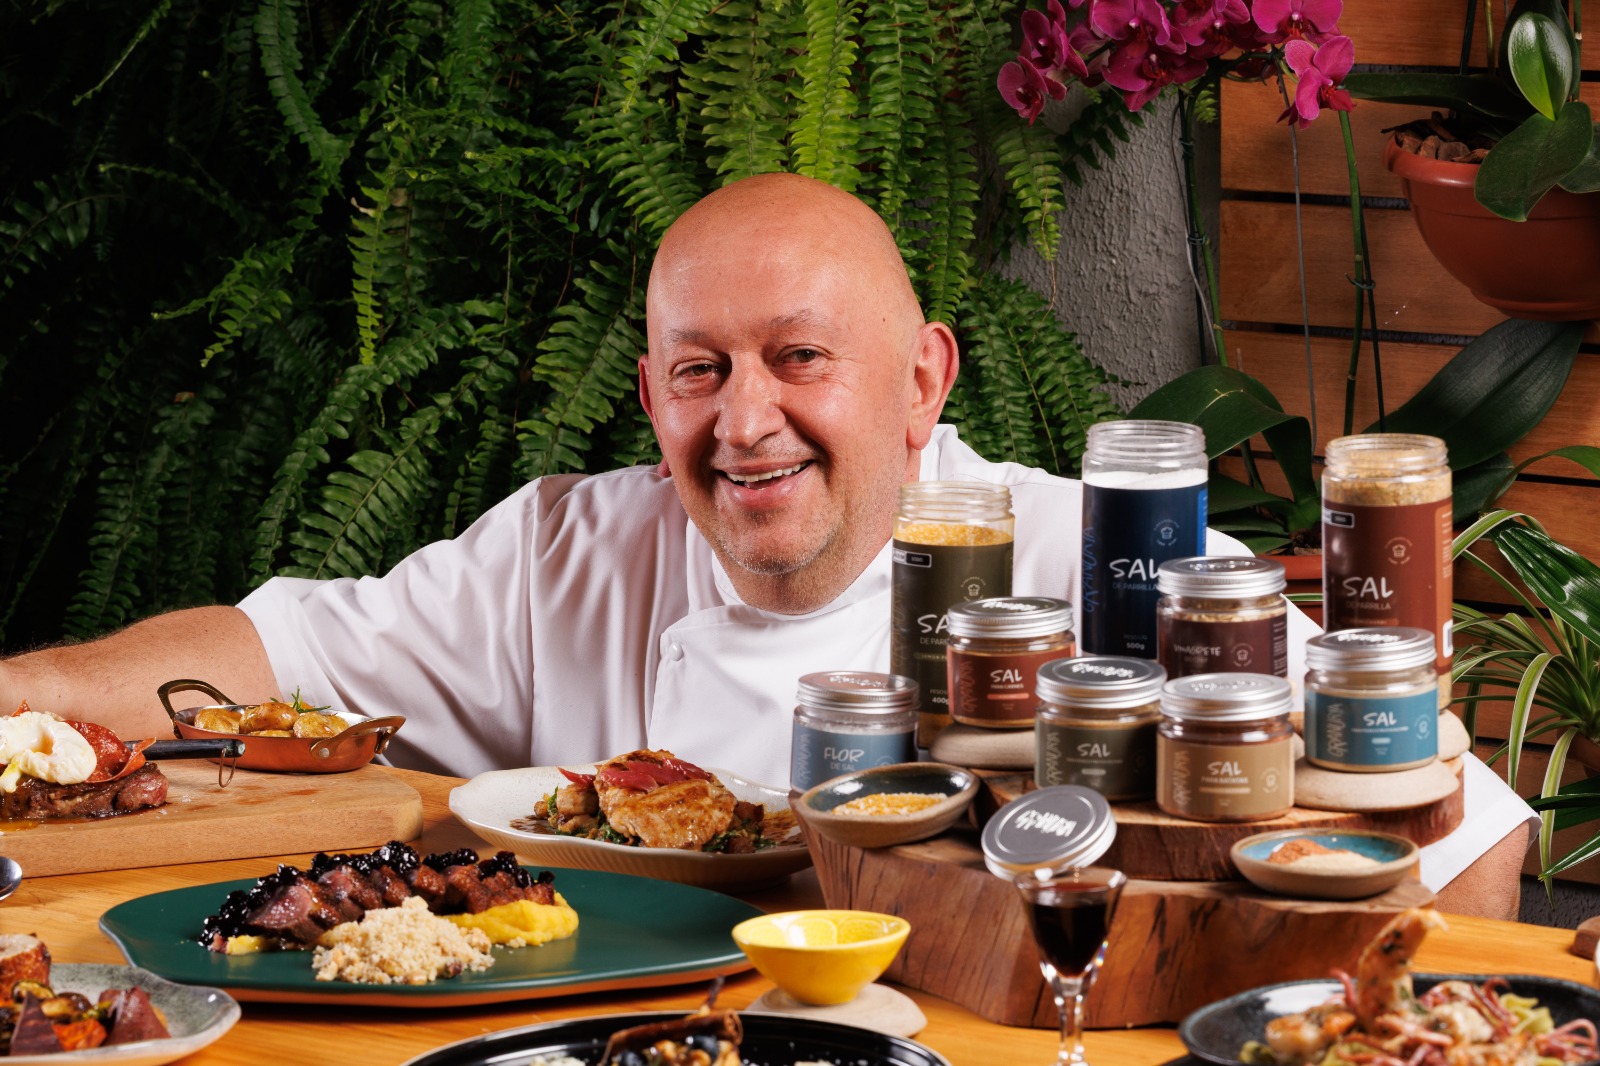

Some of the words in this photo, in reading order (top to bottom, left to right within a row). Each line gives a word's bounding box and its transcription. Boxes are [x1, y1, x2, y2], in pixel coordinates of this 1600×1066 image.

[1109, 558, 1160, 581] SAL
[1342, 576, 1394, 600] SAL
[917, 614, 950, 634] SA
[1126, 642, 1145, 650] 500g
[990, 668, 1023, 683] SAL
[1363, 711, 1397, 727] SAL
[823, 747, 865, 762] FLOR
[1077, 743, 1110, 758] SAL
[1207, 761, 1242, 777] SAL
